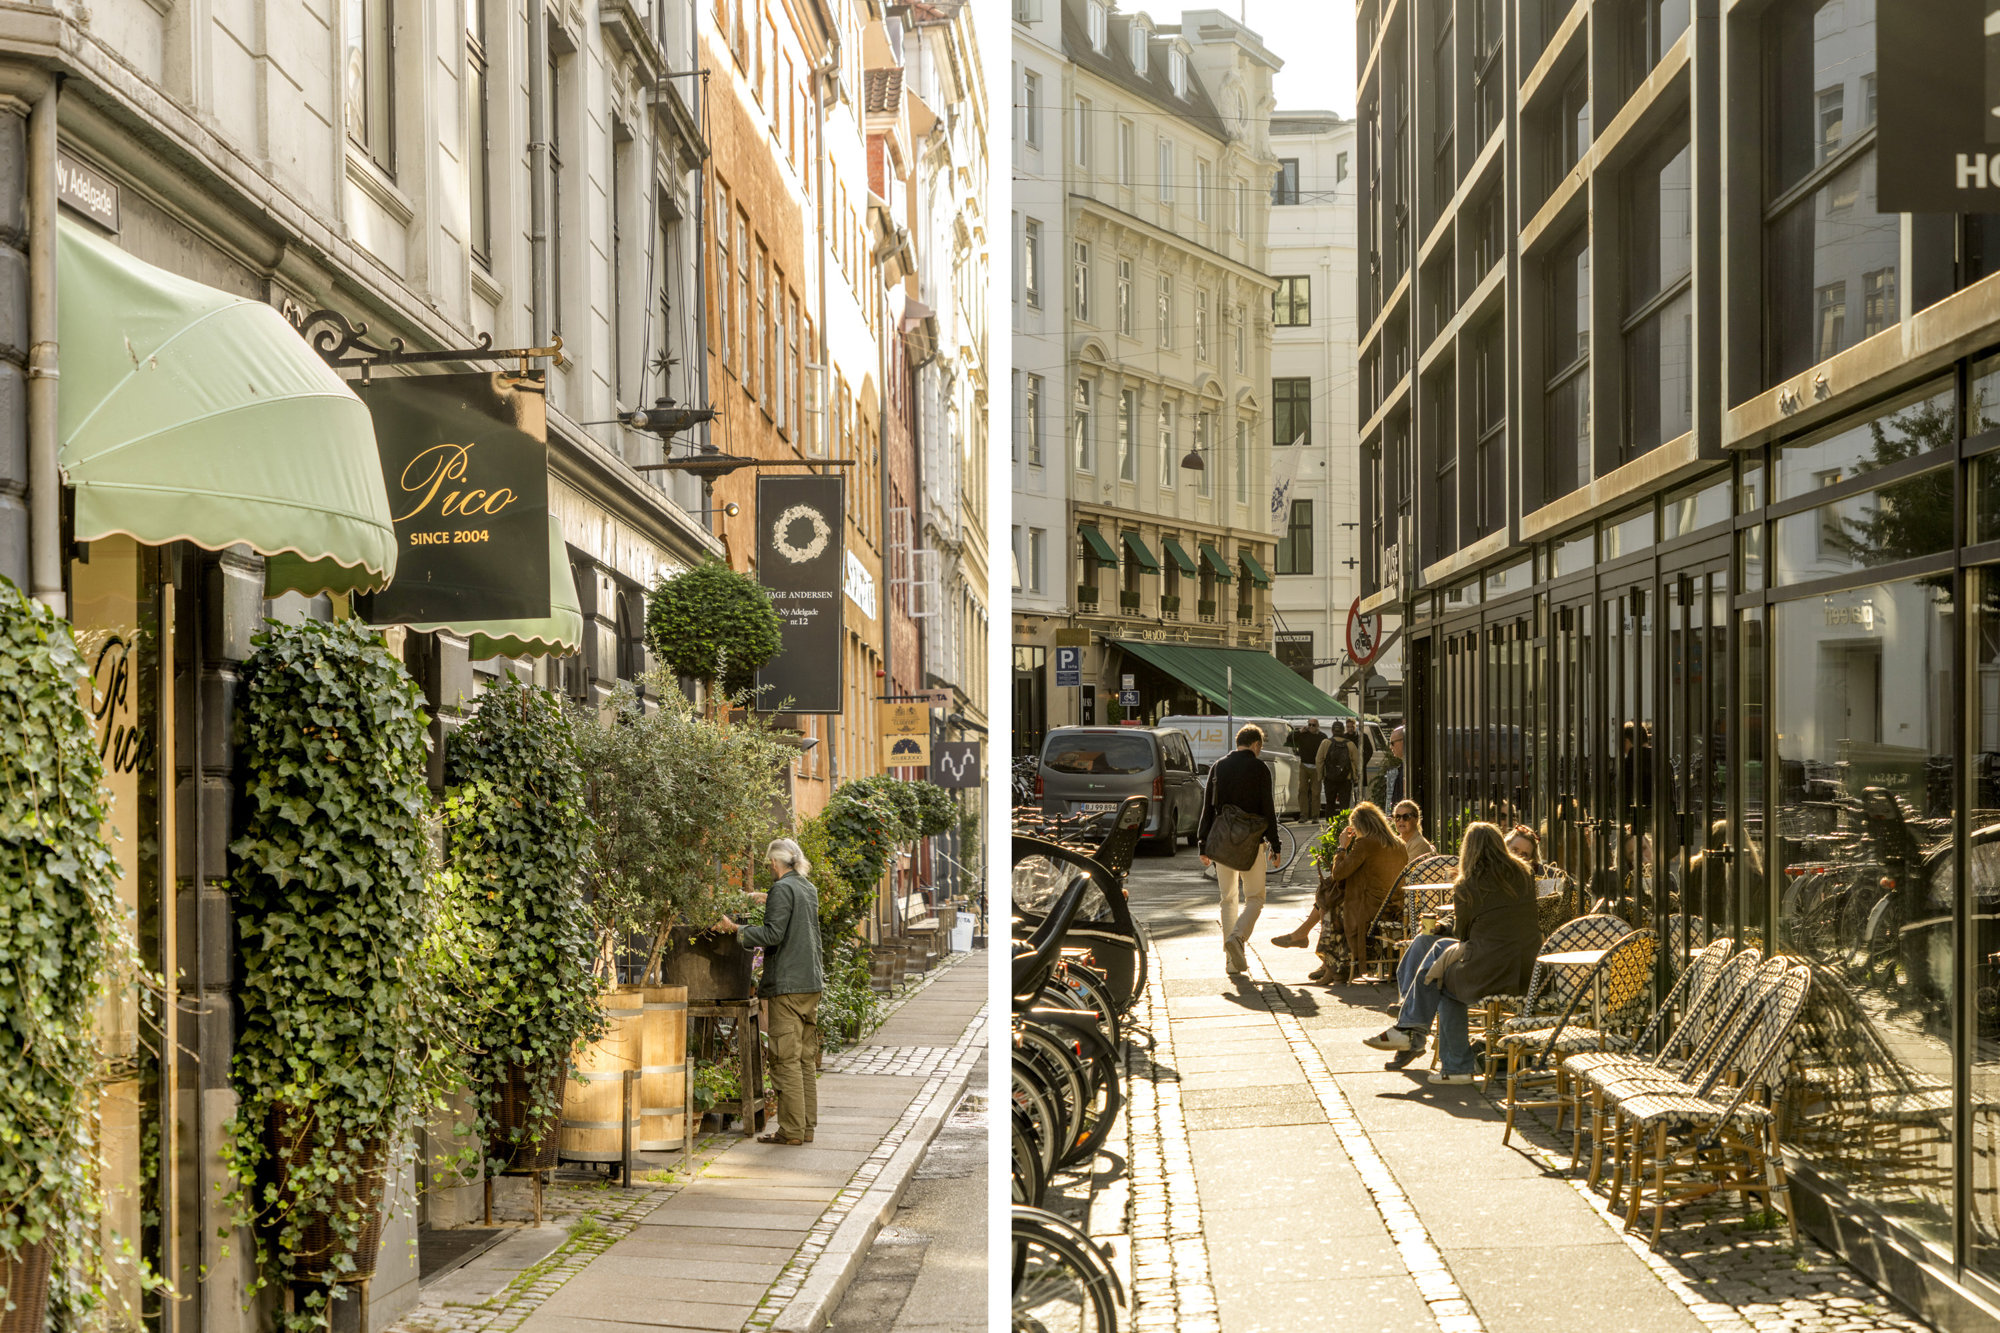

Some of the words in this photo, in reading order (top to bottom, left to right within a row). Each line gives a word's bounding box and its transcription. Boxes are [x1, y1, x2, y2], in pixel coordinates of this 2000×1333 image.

[70, 168, 112, 216] Adelgade
[392, 443, 518, 522] Pico
[410, 531, 450, 546] SINCE
[453, 529, 490, 544] 2004
[764, 591, 787, 599] TAGE
[788, 591, 833, 599] ANDERSEN
[780, 608, 790, 617] Ny
[790, 608, 819, 617] Adelgade
[799, 617, 809, 625] 12
[1060, 649, 1075, 669] P
